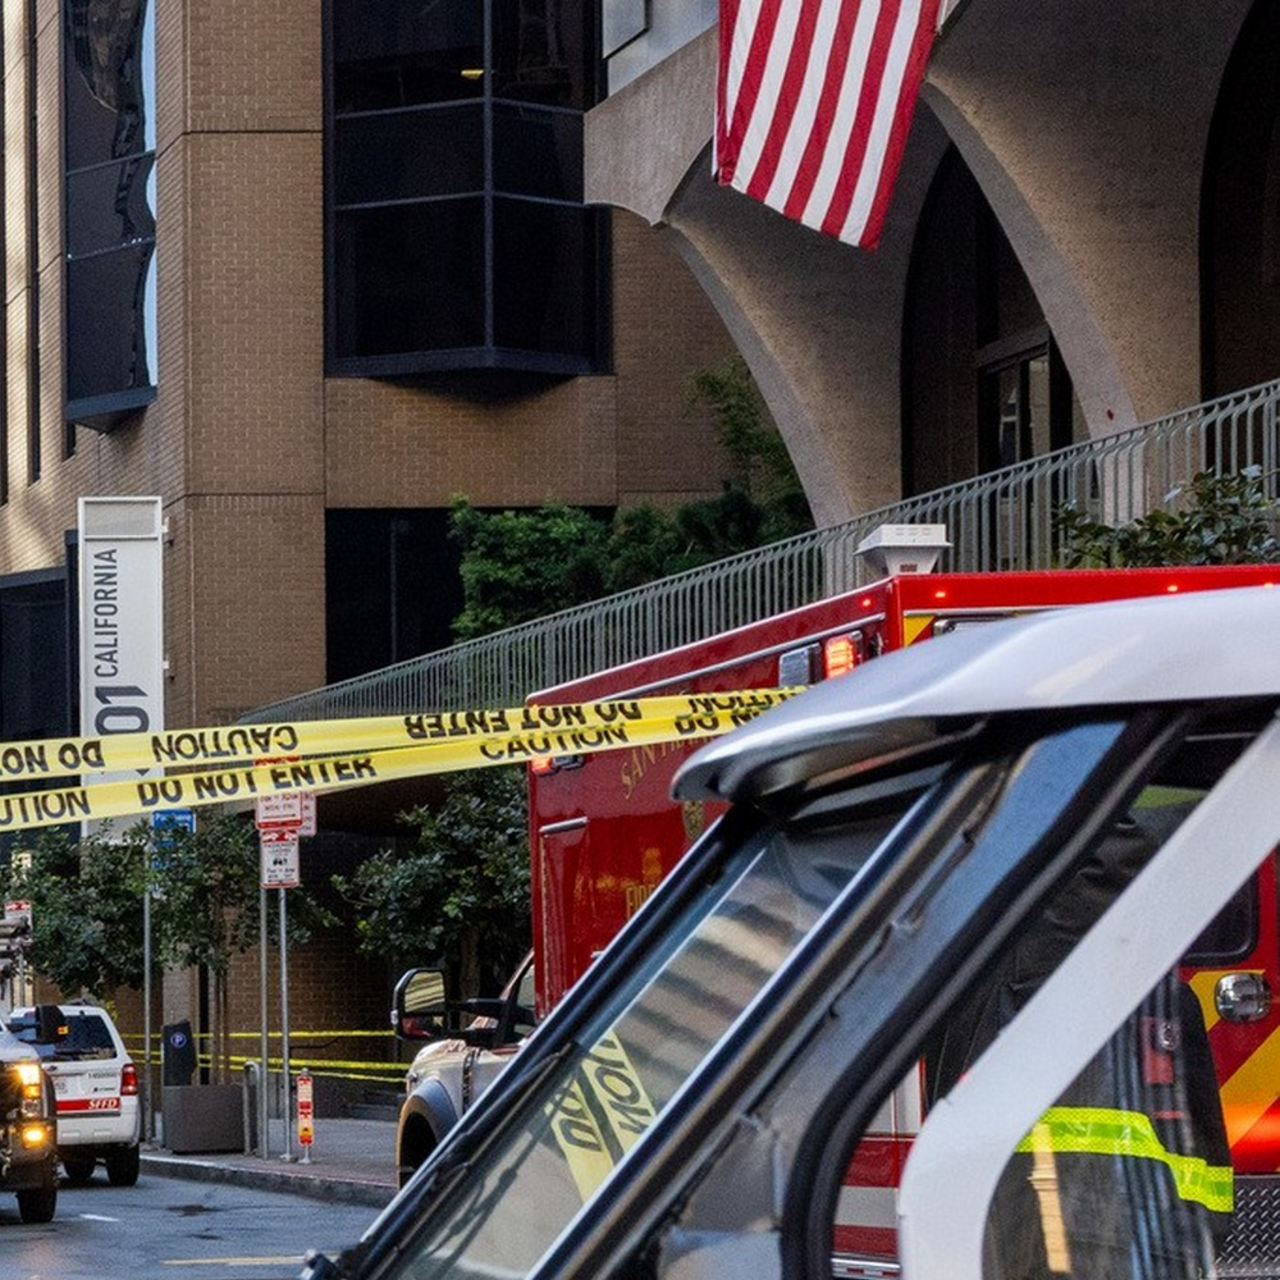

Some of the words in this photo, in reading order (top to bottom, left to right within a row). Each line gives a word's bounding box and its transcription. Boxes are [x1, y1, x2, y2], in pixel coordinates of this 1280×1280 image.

[94, 548, 118, 678] CALIFORNIA
[406, 709, 510, 740] ENTER
[522, 703, 587, 733] NOT
[595, 701, 642, 726] DO
[59, 741, 104, 768] DO
[152, 725, 298, 763] CAUTION
[138, 776, 182, 807] DO
[194, 771, 258, 800] NOT
[271, 755, 378, 788] ENTER
[88, 1098, 118, 1110] SFFD
